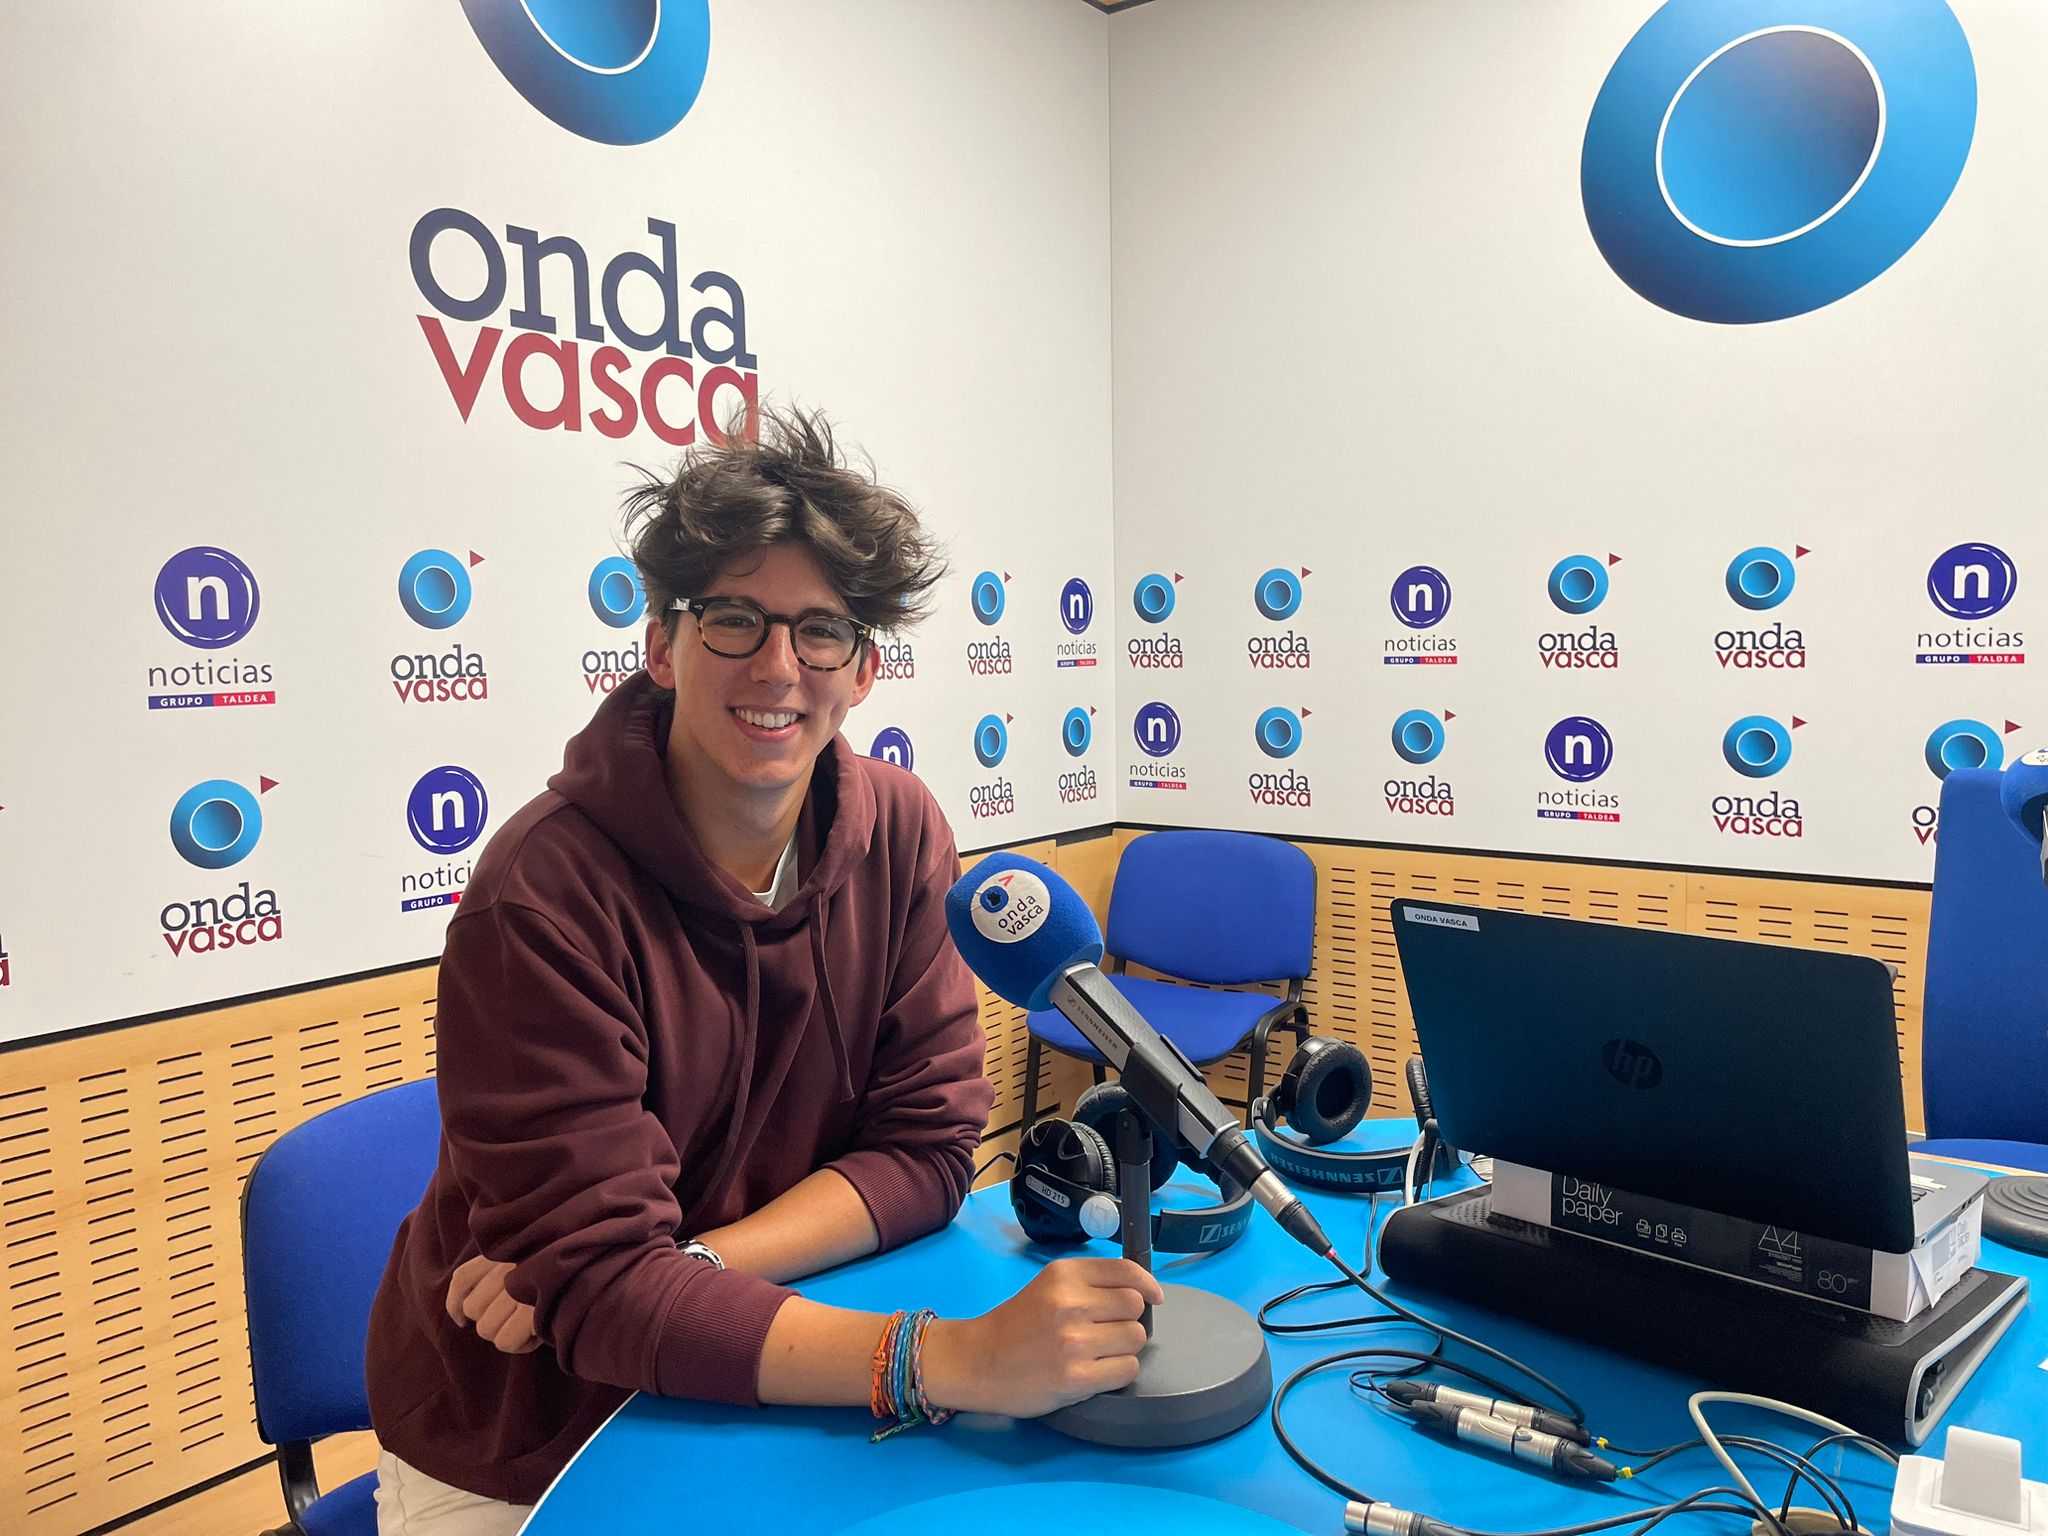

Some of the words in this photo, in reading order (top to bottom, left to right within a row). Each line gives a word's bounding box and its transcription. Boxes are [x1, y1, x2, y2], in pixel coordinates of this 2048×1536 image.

[410, 207, 758, 370] onda
[416, 315, 759, 452] vasca
[967, 635, 1012, 660] onda
[1057, 640, 1097, 656] noticias
[1127, 632, 1183, 655] onda
[1247, 630, 1310, 654] onda
[1384, 634, 1457, 652] noticias
[1538, 625, 1618, 651] onda
[1714, 622, 1806, 650] onda
[1917, 627, 2024, 648] noticias
[390, 644, 487, 679] onda
[878, 639, 914, 663] nda
[1128, 652, 1183, 669] vasca
[1248, 651, 1311, 669] vasca
[1539, 649, 1618, 669] vasca
[1715, 648, 1806, 669] vasca
[1924, 655, 1960, 663] GRUPO
[1976, 655, 2017, 663] TALDEA
[148, 658, 273, 687] noticias
[876, 662, 915, 680] asca
[968, 658, 1012, 676] vasca
[160, 696, 203, 707] GRUPO
[222, 693, 268, 705] TALDEA
[392, 676, 488, 704] vasca
[1058, 765, 1097, 790] onda
[1129, 761, 1186, 778] noticias
[1248, 768, 1311, 792] onda
[969, 776, 1014, 805] onda
[1059, 784, 1097, 805] vasca
[1250, 787, 1312, 808] vasca
[1383, 775, 1454, 801] onda
[1538, 788, 1619, 808] noticias
[971, 798, 1014, 819] vasca
[1386, 796, 1455, 817] vasca
[1583, 813, 1614, 821] TALDEA
[1711, 790, 1803, 820] onda
[1713, 814, 1803, 838] vasca
[402, 859, 472, 893] notici
[160, 881, 281, 932] onda
[410, 896, 444, 909] GRUPO
[998, 895, 1037, 929] onda
[1006, 904, 1044, 936] vasca
[1414, 913, 1438, 923] ONDA
[1439, 917, 1468, 928] VASCA
[162, 914, 283, 957] vasca
[1611, 1039, 1655, 1090] hp
[1041, 1185, 1052, 1197] HD
[1052, 1192, 1066, 1205] 215
[1562, 1174, 1613, 1209] Daily
[1562, 1196, 1624, 1226] paper
[1758, 1224, 1802, 1255] A4
[1817, 1270, 1847, 1294] 80
